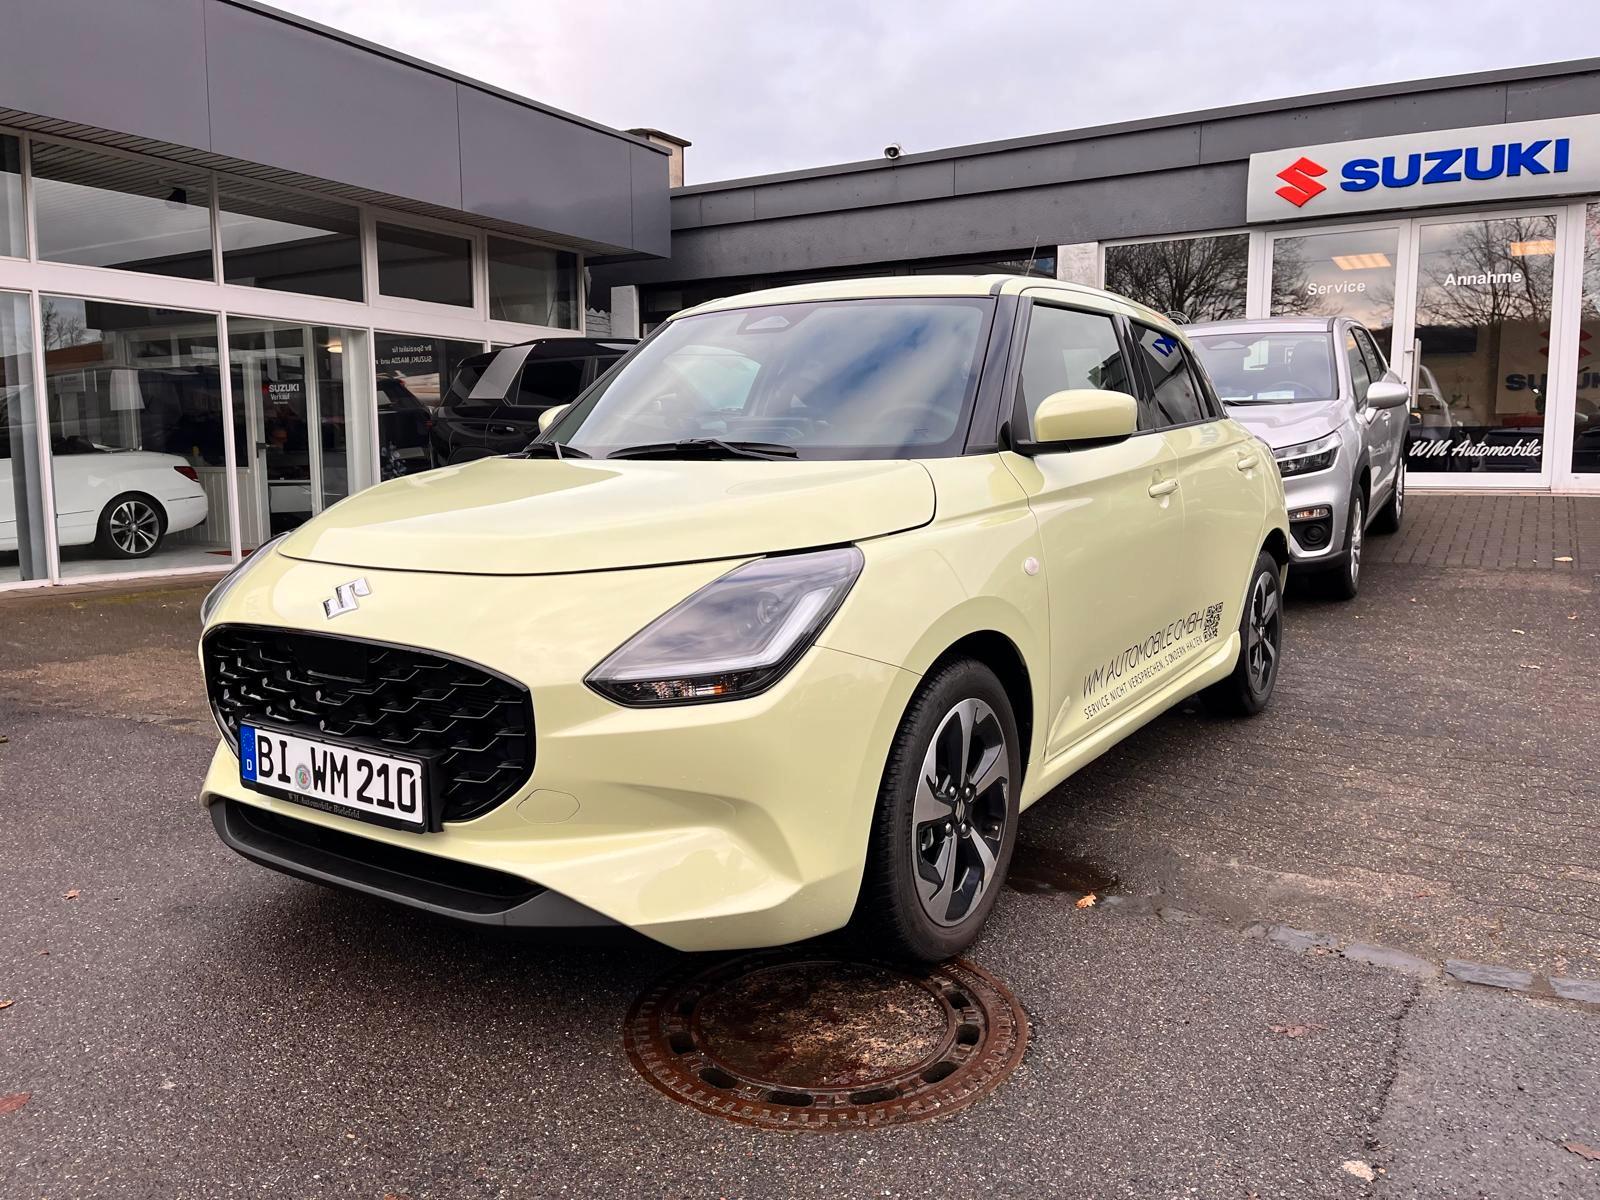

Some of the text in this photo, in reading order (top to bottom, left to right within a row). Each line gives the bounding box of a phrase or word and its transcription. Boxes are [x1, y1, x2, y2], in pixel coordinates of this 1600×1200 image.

[1340, 138, 1570, 192] SUZUKI
[1307, 281, 1366, 296] Service
[1443, 271, 1522, 287] Annahme
[269, 384, 300, 393] SUZUKI
[1408, 438, 1542, 459] WM Automobile
[1083, 665, 1105, 699] WM
[1105, 623, 1175, 687] AUTOMOBILE
[1083, 694, 1110, 720] SERVICE
[1110, 681, 1128, 700] NICHT
[246, 758, 253, 771] D
[257, 735, 416, 814] BI WM 210
